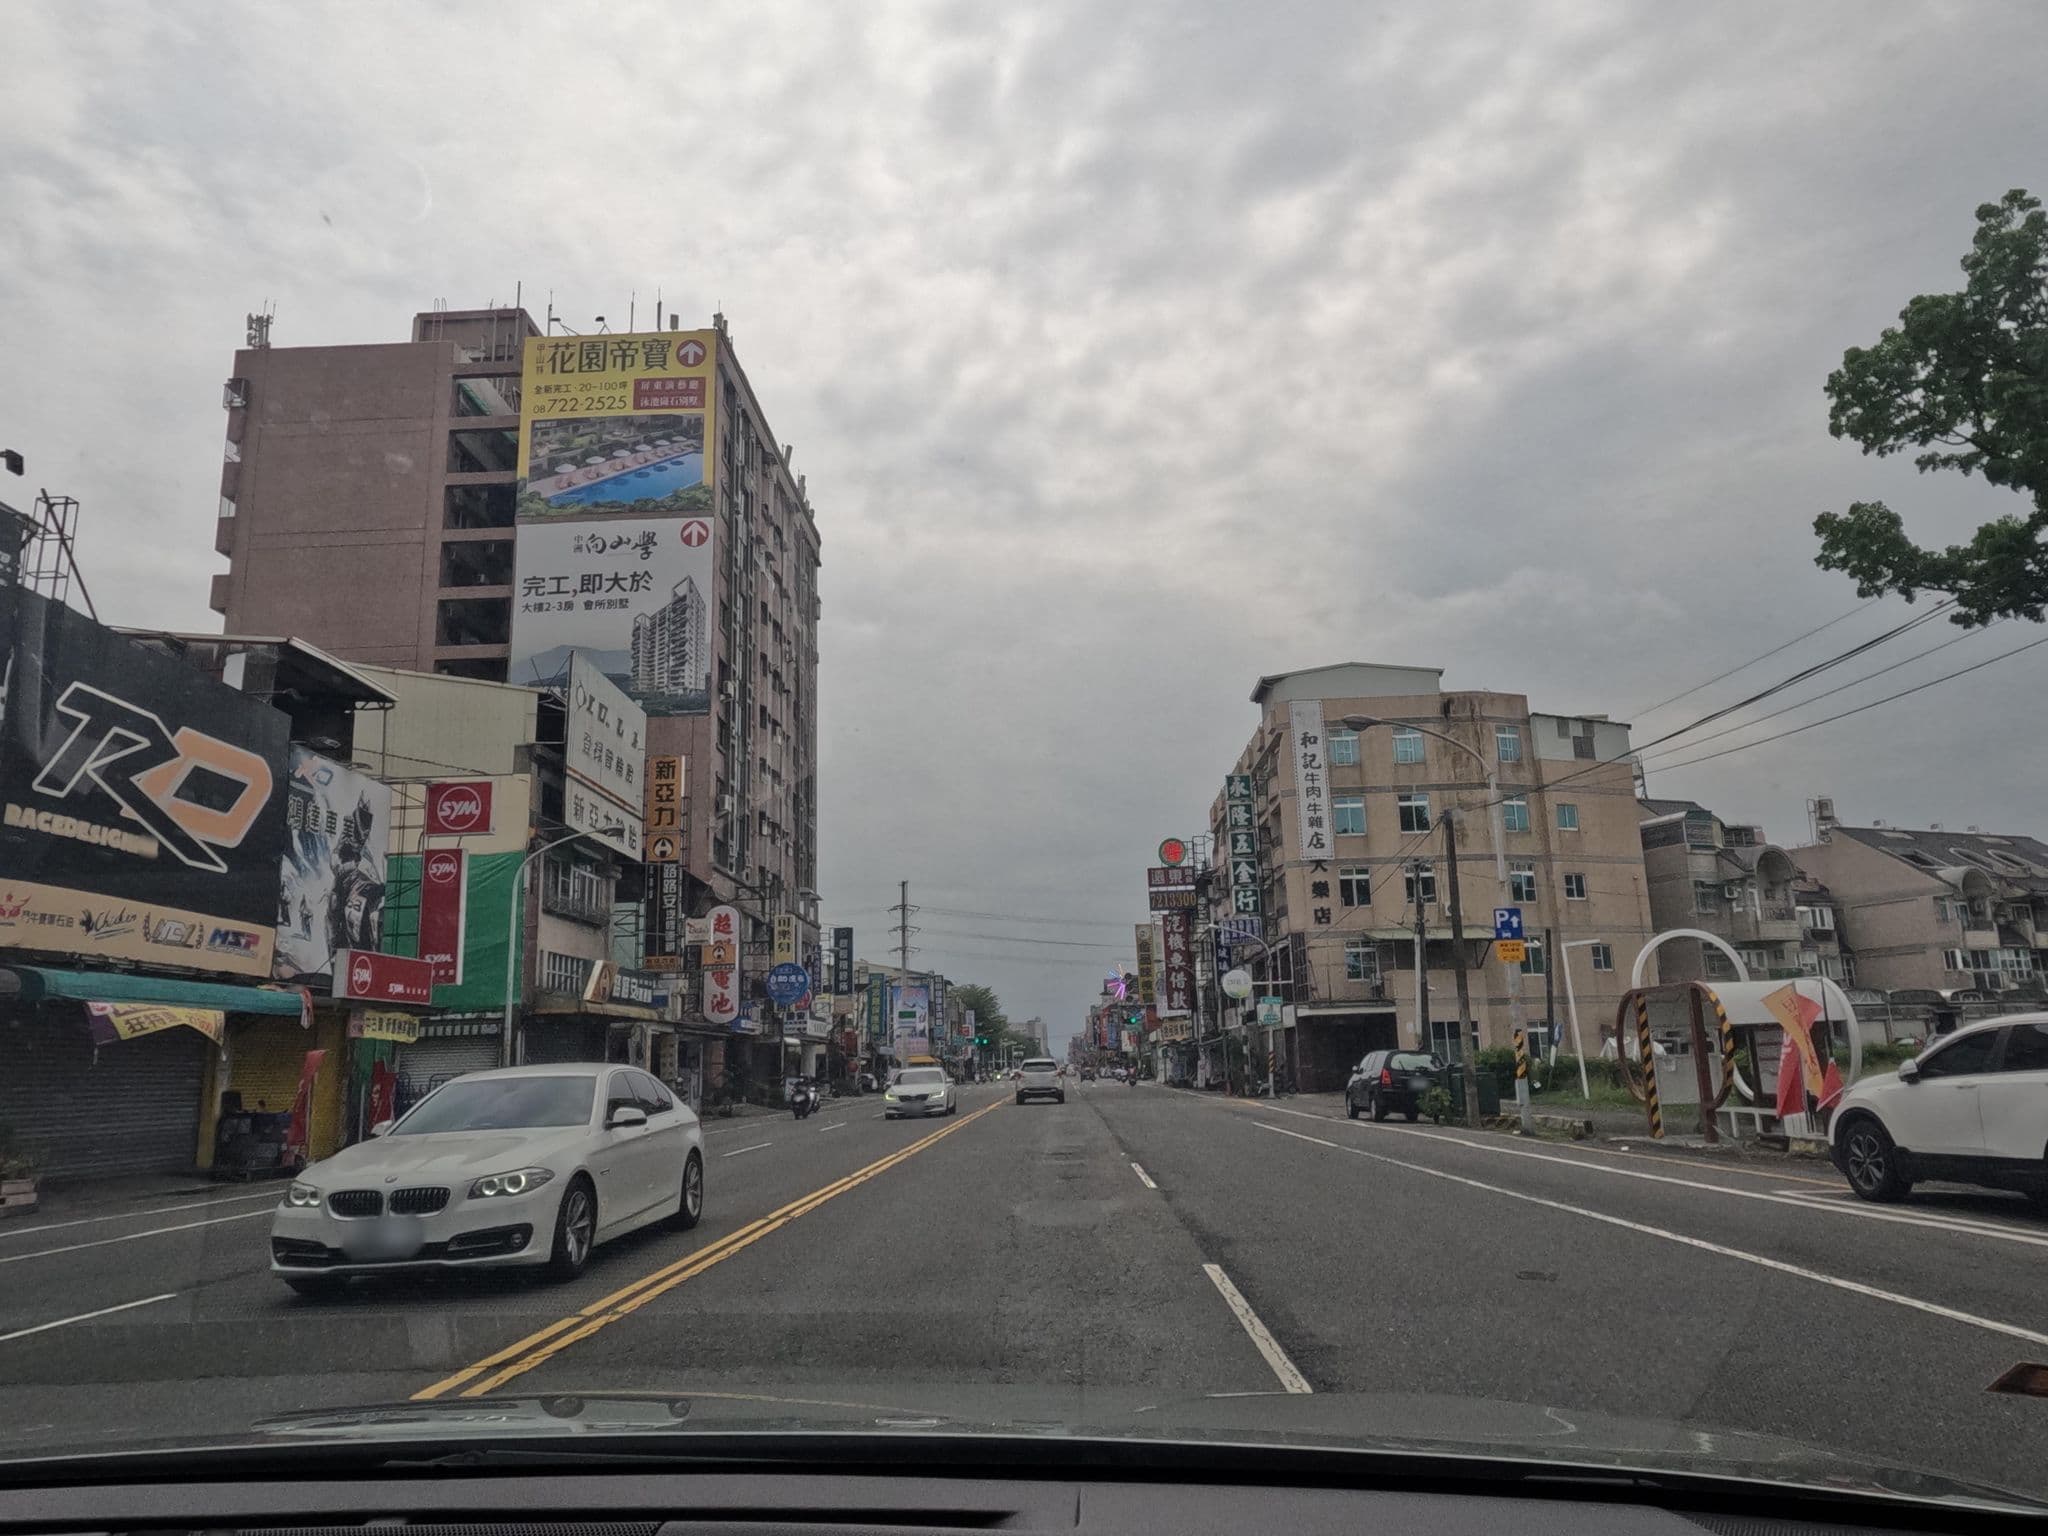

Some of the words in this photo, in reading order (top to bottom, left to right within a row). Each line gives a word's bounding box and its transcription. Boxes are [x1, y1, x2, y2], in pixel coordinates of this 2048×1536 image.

[547, 338, 672, 375] 花園帝寶
[654, 759, 676, 827] 新亞力
[439, 800, 481, 821] SYM
[1229, 776, 1258, 912] 永隆五金行
[429, 861, 457, 876] SYM
[1494, 909, 1509, 929] P
[353, 967, 371, 985] SYM
[1166, 914, 1188, 1009] 汽機車借款
